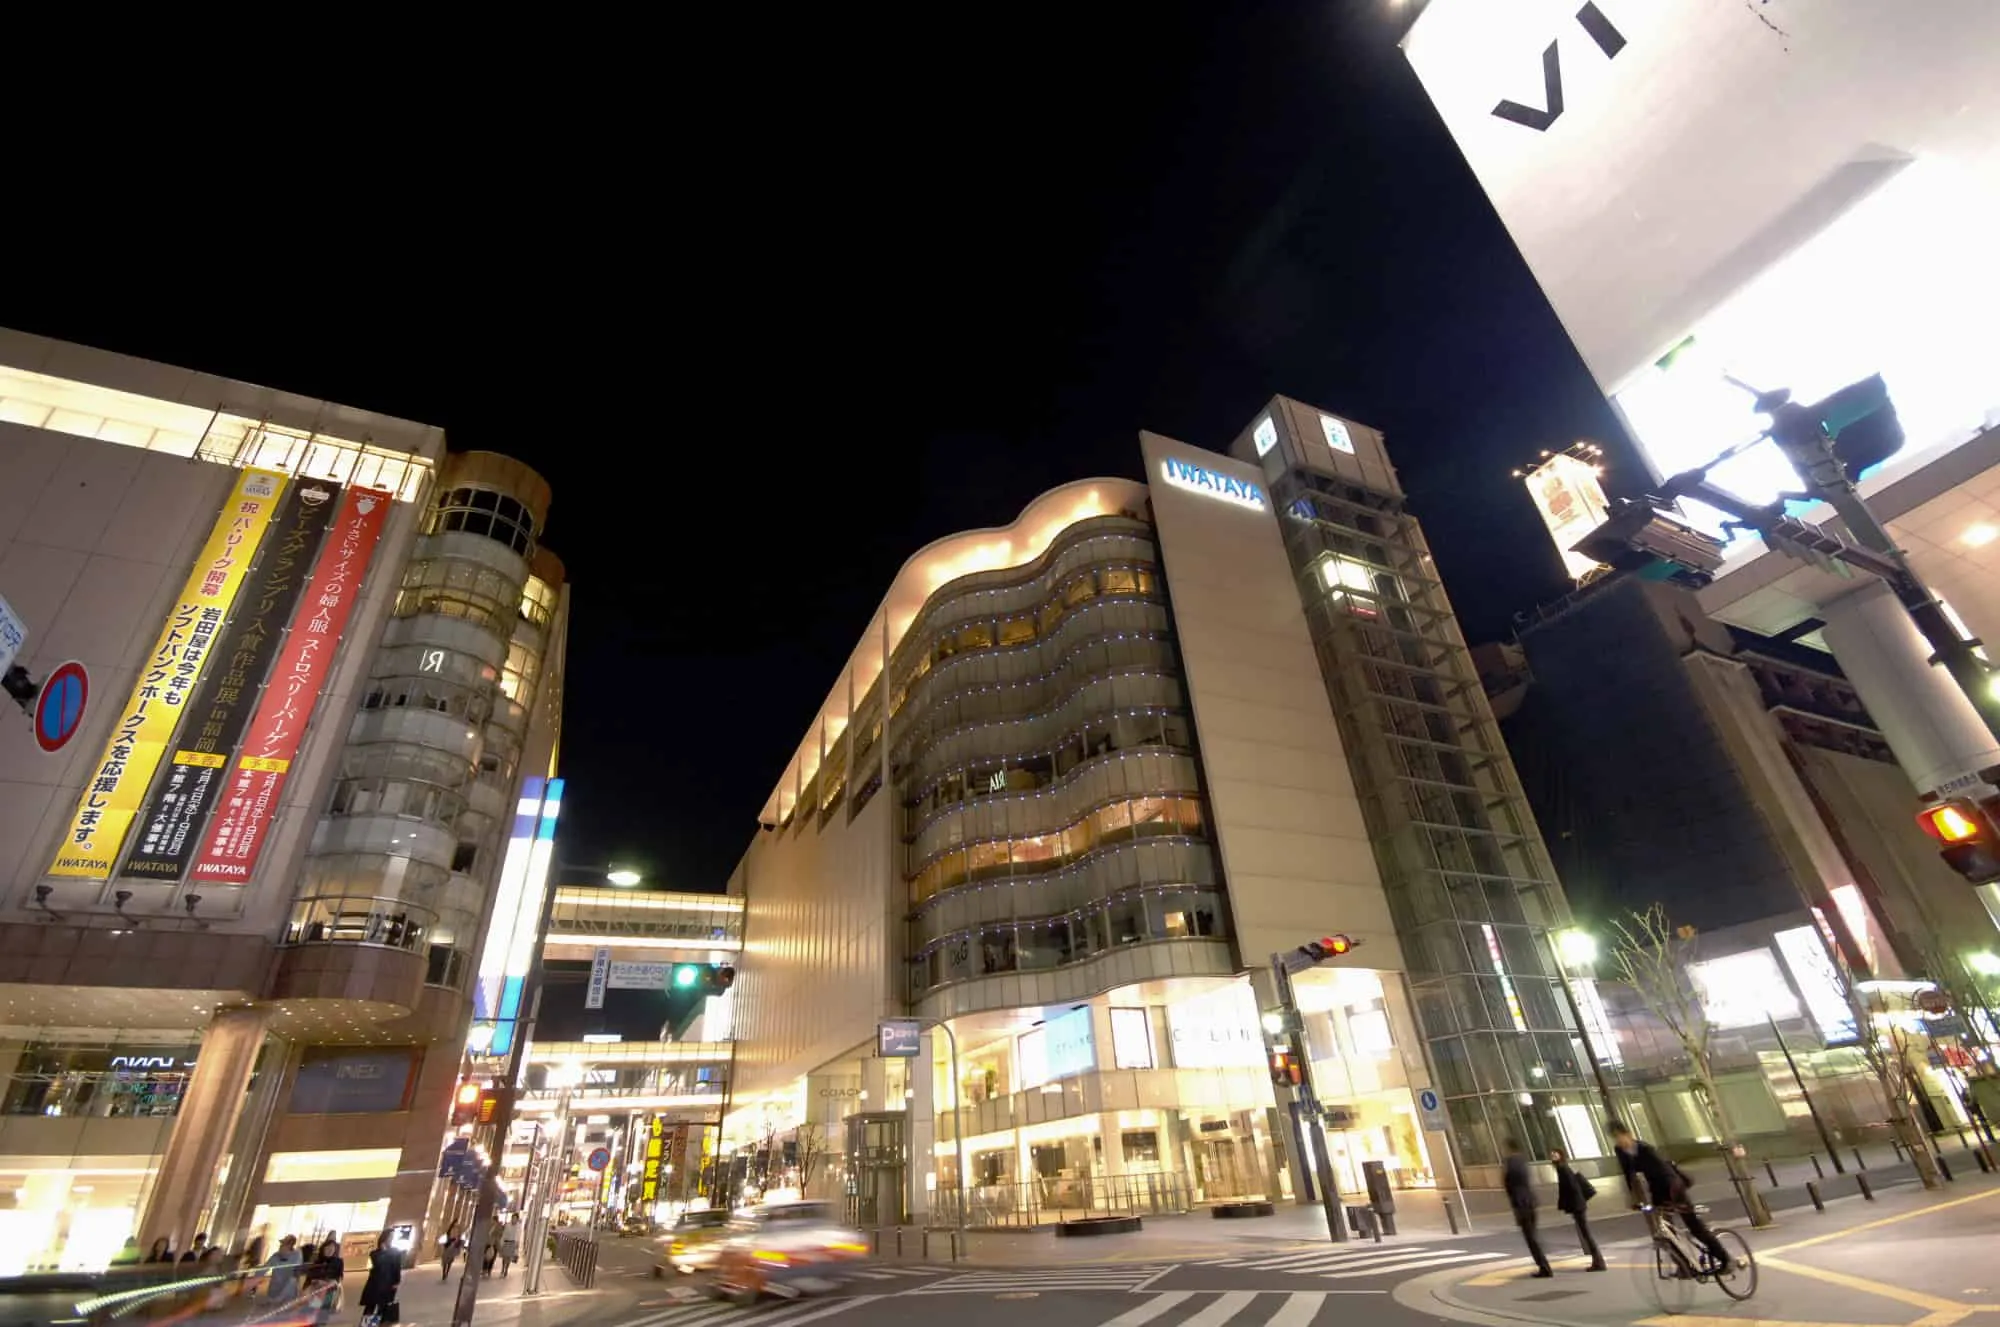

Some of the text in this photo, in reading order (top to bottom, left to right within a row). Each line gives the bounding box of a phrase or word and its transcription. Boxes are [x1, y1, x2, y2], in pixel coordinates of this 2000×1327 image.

[1165, 456, 1265, 504] IWATAYA
[239, 501, 260, 515] 祝
[307, 517, 367, 634] 小さいサイズの婦人服
[164, 606, 223, 706] 岩田屋は今年も
[259, 637, 321, 758] ストロベリーバーゲン
[75, 602, 199, 851] ソフトバンクホークスを応援します。
[56, 858, 108, 870] IWATAYA
[127, 859, 179, 874] IWATAYA
[196, 863, 247, 876] IWATAYA
